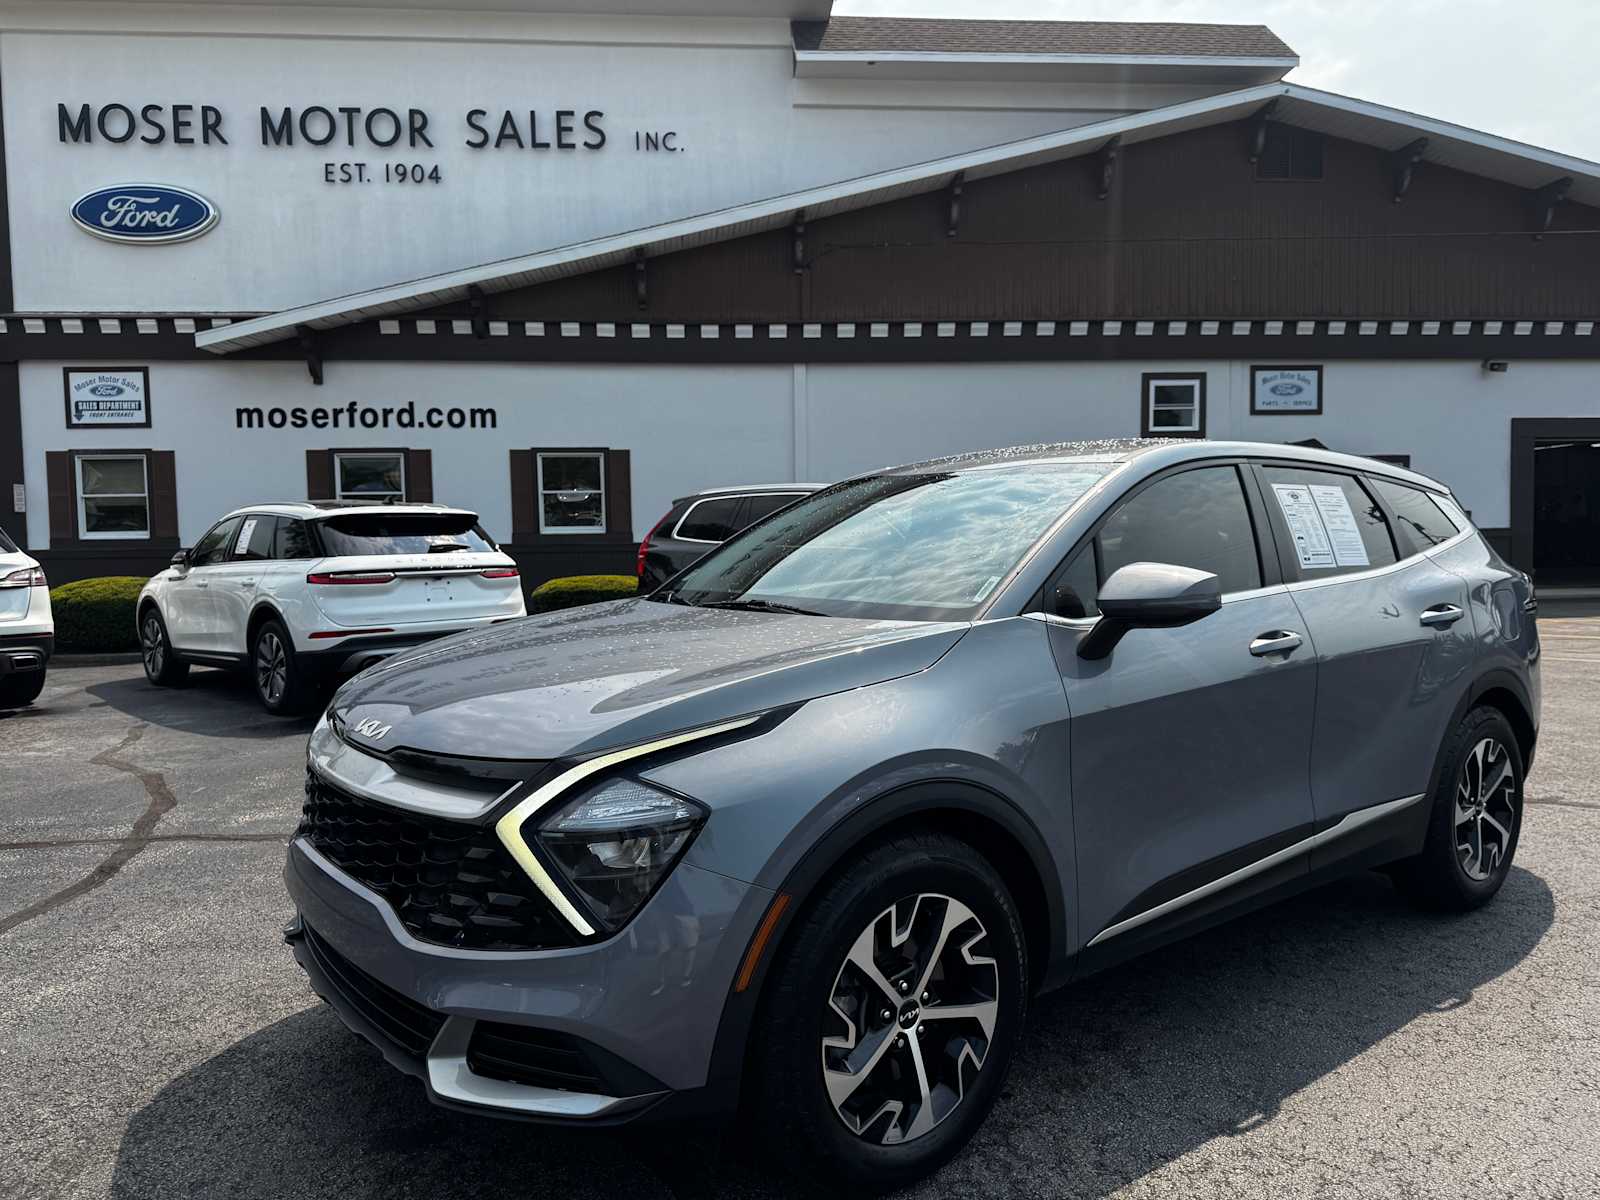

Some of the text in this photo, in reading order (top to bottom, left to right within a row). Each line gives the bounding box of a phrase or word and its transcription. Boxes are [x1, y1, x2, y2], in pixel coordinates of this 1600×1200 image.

[58, 104, 684, 151] MOSER MOTOR SALES INC.
[325, 164, 441, 184] EST. 1904
[100, 195, 181, 227] Ford
[74, 375, 140, 393] Moser Motor Sales
[95, 384, 118, 395] Ford
[78, 401, 139, 410] SALES DEPARTMENT
[236, 401, 497, 429] moserford.com
